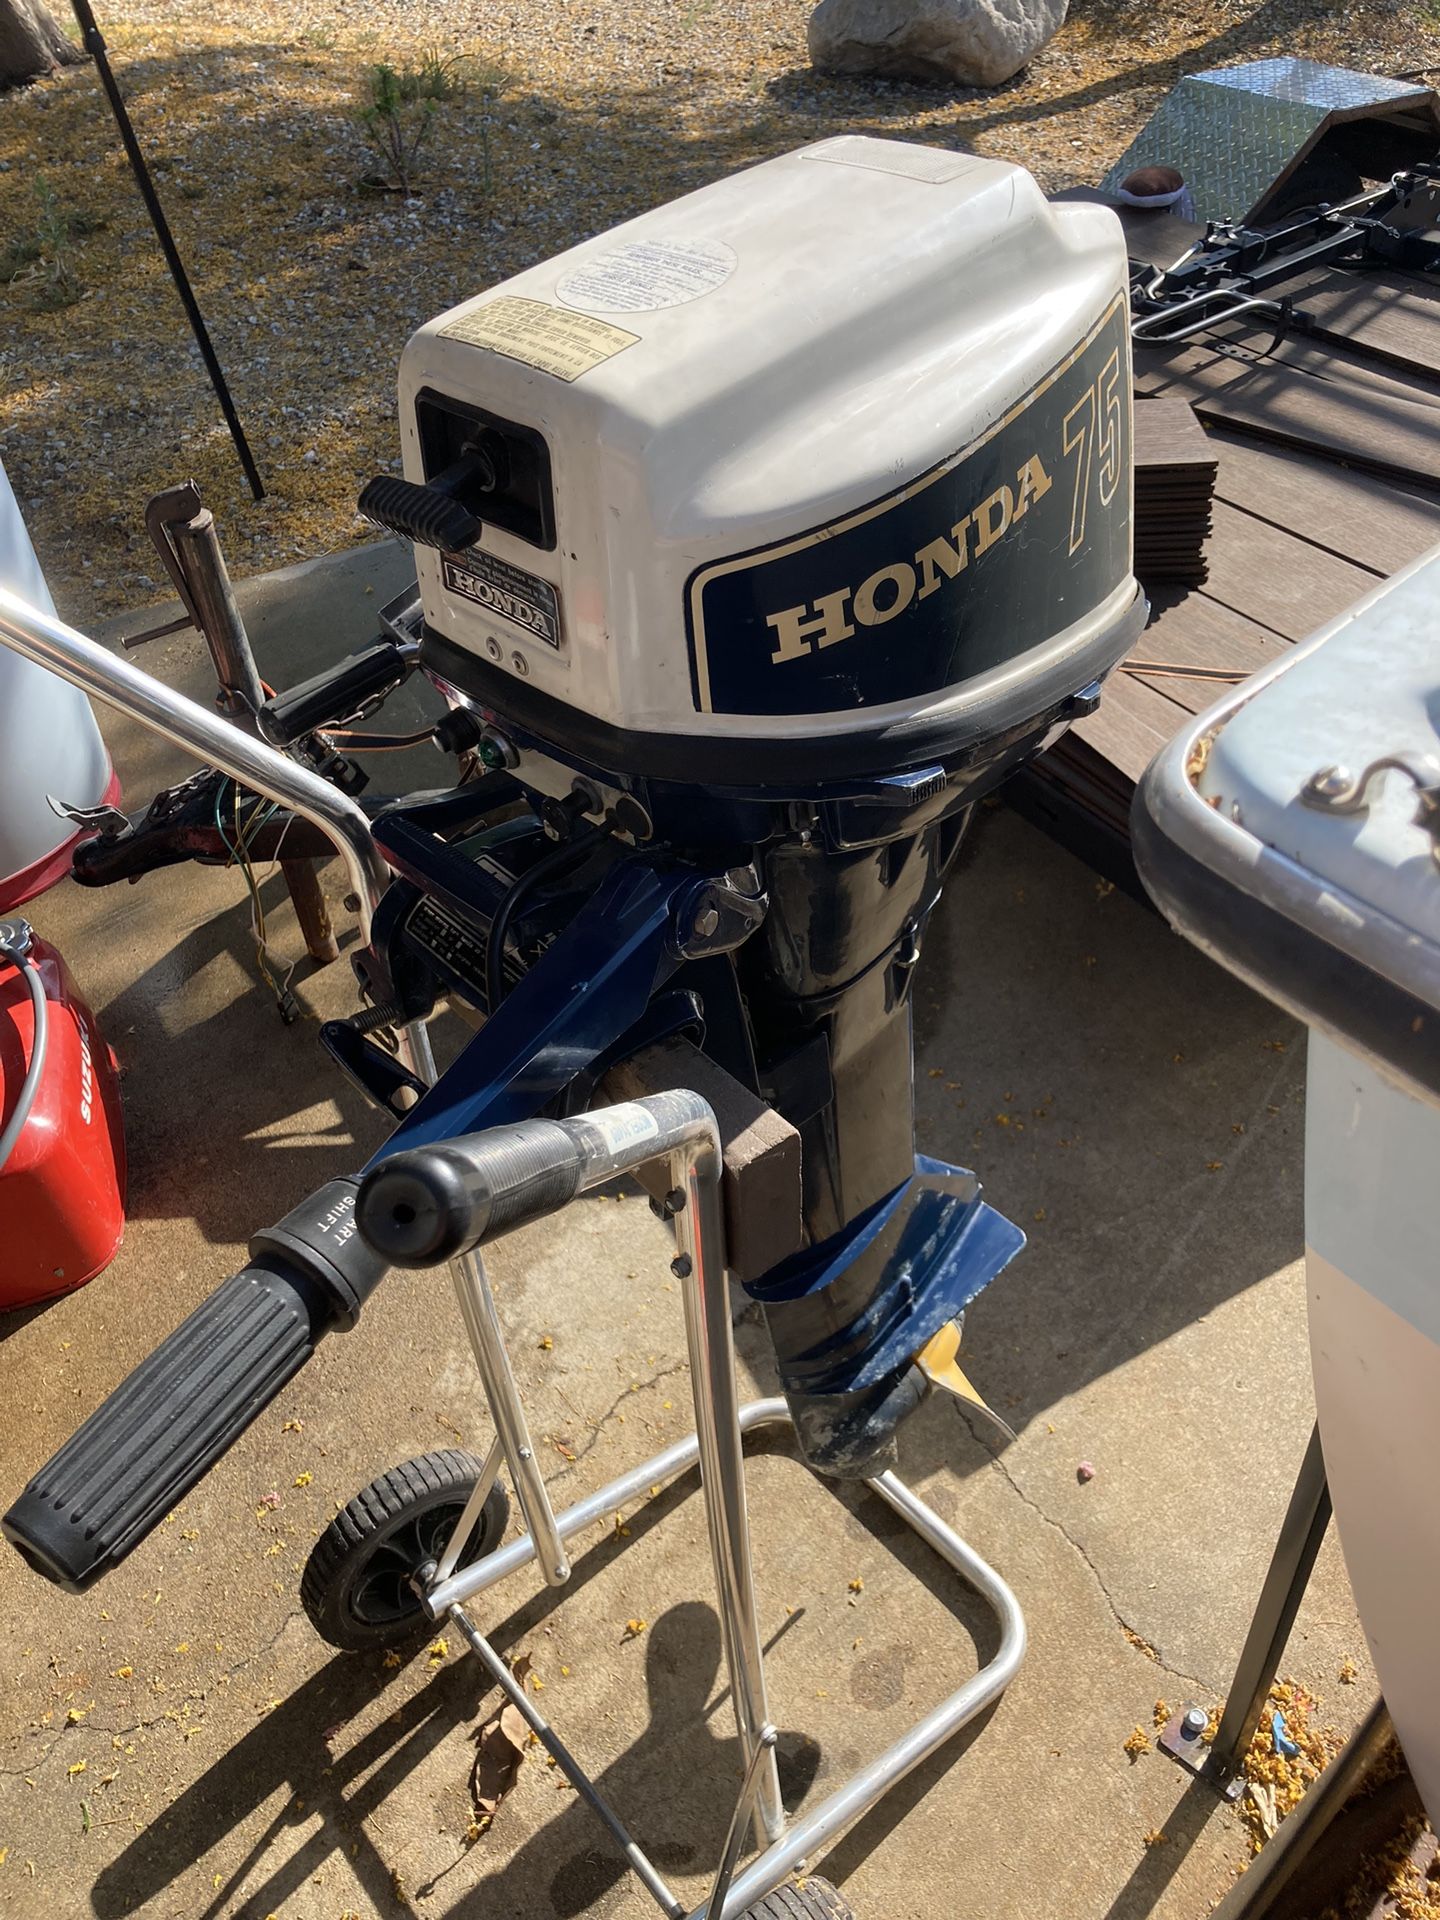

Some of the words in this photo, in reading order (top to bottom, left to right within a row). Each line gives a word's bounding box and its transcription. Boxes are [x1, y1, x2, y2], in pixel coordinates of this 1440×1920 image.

[766, 454, 1052, 665] HONDA
[1063, 347, 1122, 558] 75
[452, 569, 551, 637] HONDA
[79, 1014, 92, 1125] SUZUKI
[317, 1196, 355, 1232] SHIFT
[334, 1218, 357, 1246] ART
